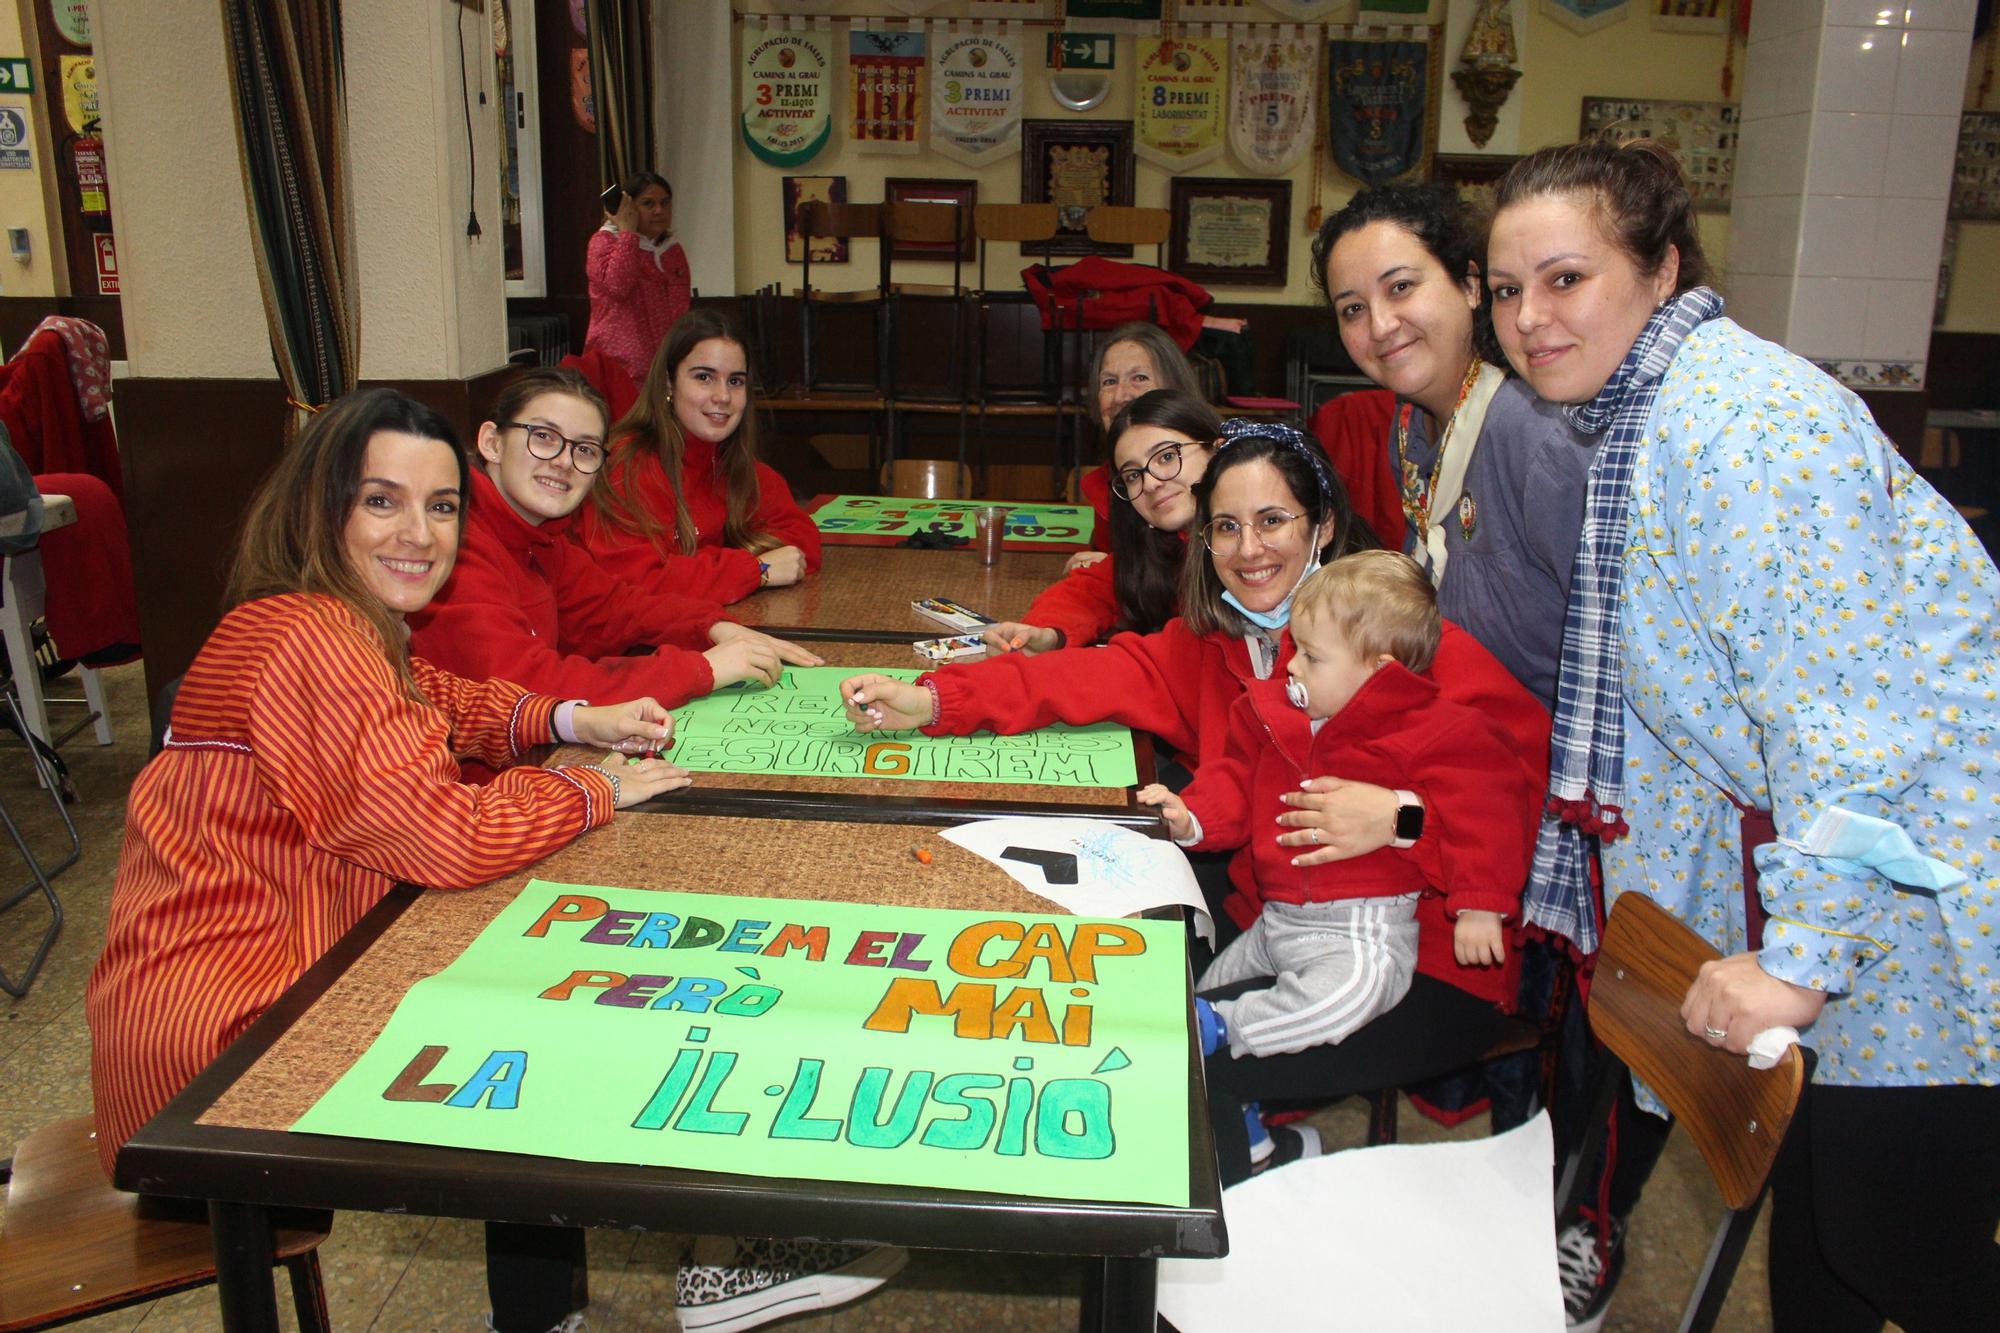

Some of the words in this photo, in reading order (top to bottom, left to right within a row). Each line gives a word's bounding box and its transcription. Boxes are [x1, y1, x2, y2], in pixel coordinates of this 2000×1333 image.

[753, 71, 785, 79] CAMINS
[944, 70, 975, 78] CAMINS
[756, 84, 773, 106] 3
[776, 84, 818, 97] PREMI
[860, 83, 914, 93] ACCESSIT
[944, 80, 961, 104] 3
[965, 88, 1010, 102] PREMI
[1153, 86, 1167, 107] 8
[1169, 92, 1209, 105] PREMI
[758, 109, 816, 118] ACTIVITAT
[880, 95, 892, 116] 3
[946, 106, 1008, 117] ACTIVITAT
[1266, 104, 1279, 126] 5
[645, 736, 1100, 784] ESURGIREM
[522, 894, 831, 962] PERDEM
[843, 930, 932, 972] EL
[947, 920, 1148, 985] CAP
[537, 965, 783, 1018] PERÒ
[382, 1044, 529, 1110] LA
